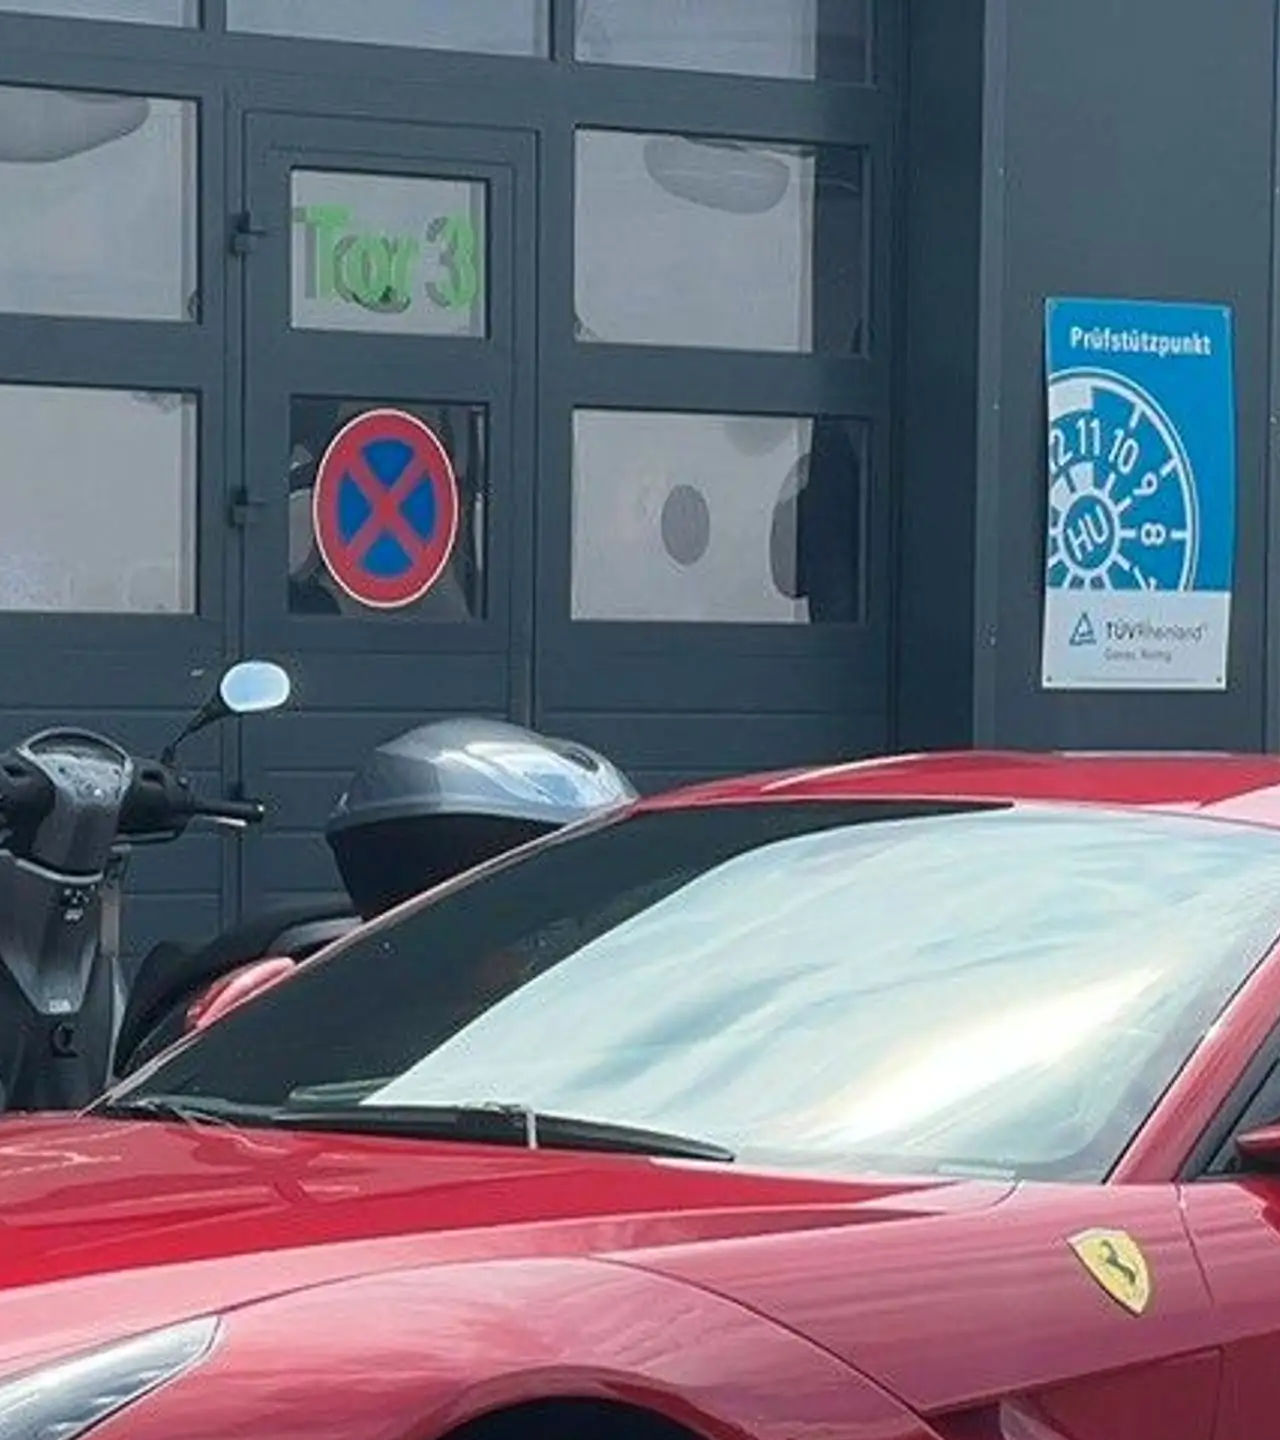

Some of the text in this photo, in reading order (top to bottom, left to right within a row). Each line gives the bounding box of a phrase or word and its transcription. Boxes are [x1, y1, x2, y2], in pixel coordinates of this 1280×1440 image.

[306, 203, 477, 309] Tor 3
[1070, 326, 1212, 358] Prüfstützpunkt
[1107, 427, 1140, 474] 10
[1066, 503, 1111, 562] HU
